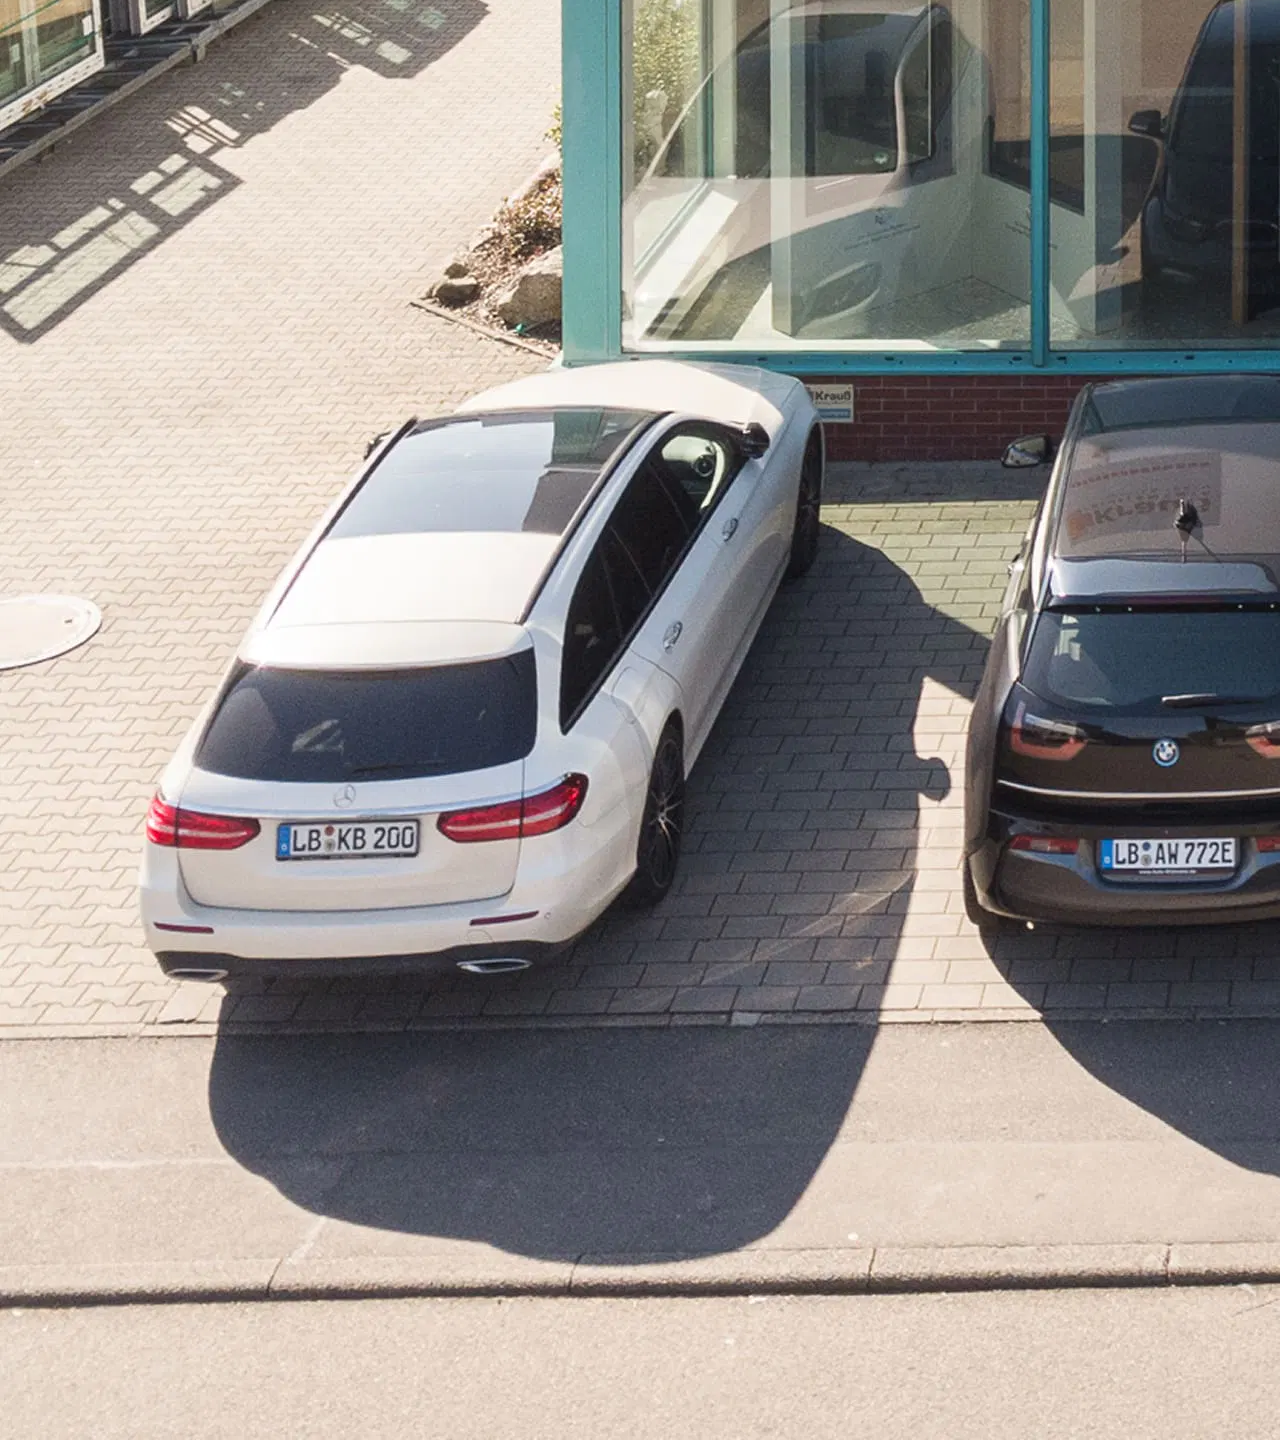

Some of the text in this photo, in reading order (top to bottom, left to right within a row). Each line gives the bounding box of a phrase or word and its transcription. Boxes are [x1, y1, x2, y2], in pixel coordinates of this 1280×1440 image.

[293, 826, 415, 852] LB KB 200
[1115, 841, 1233, 865] LB AW 772E
